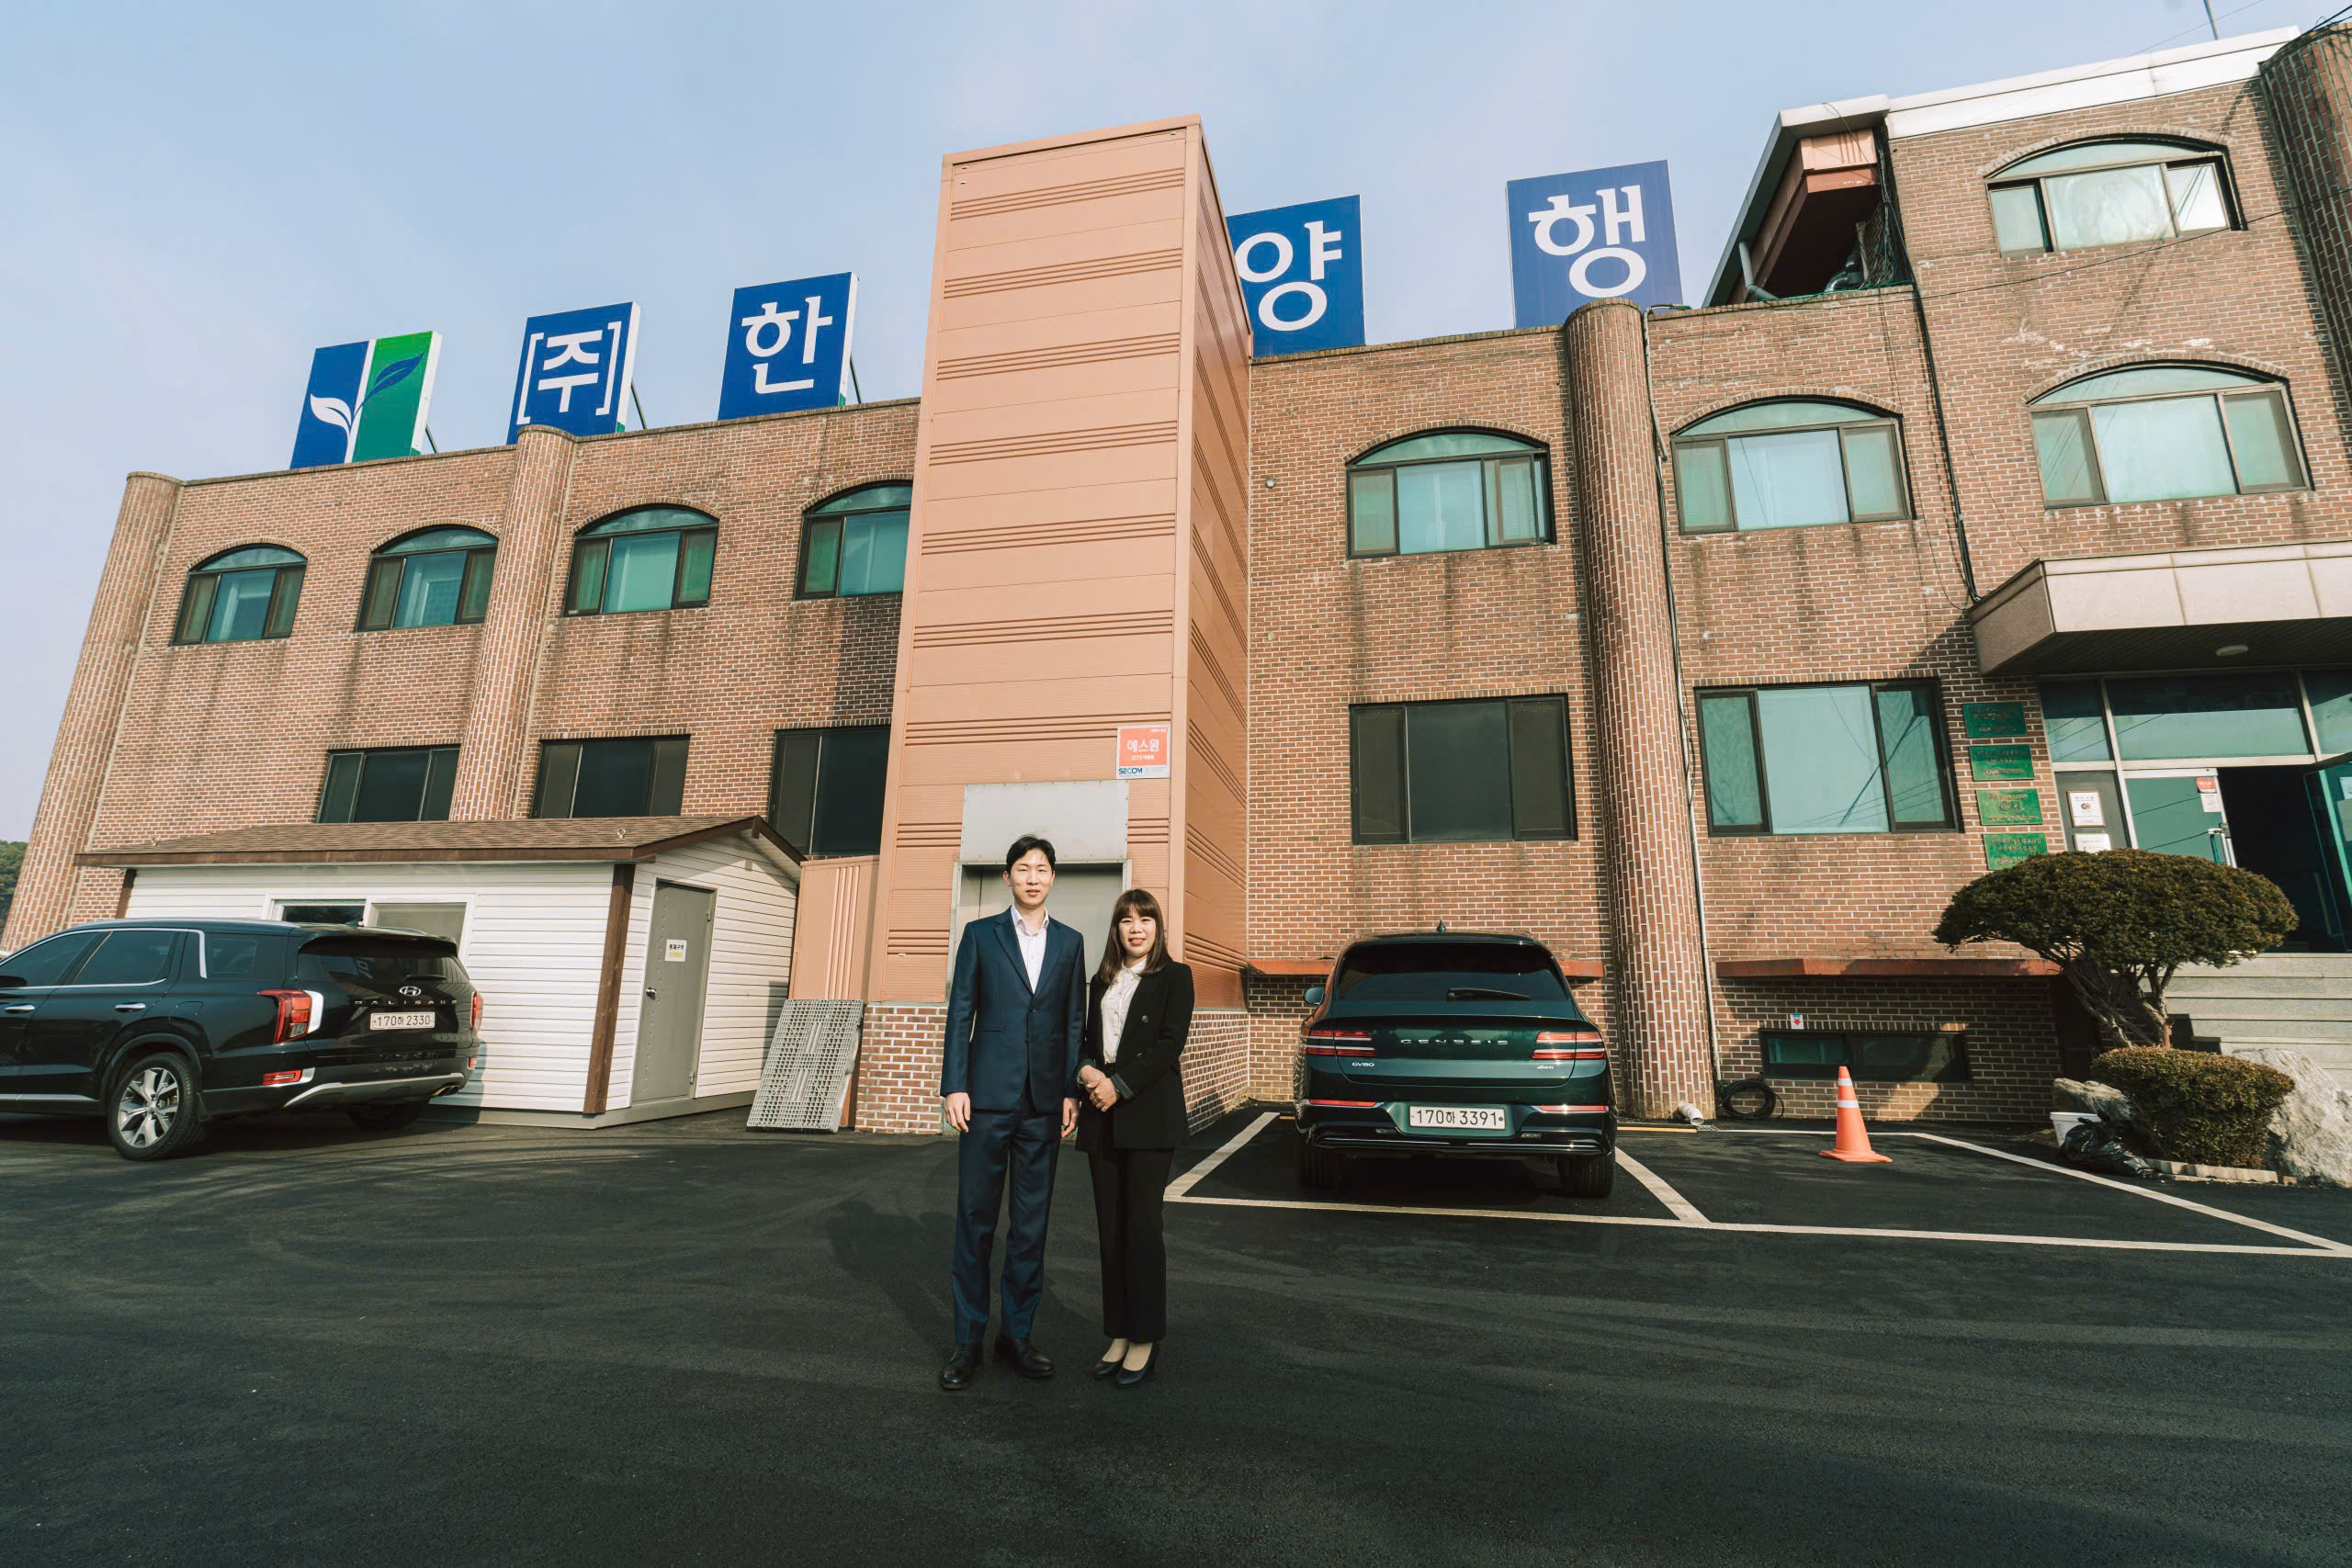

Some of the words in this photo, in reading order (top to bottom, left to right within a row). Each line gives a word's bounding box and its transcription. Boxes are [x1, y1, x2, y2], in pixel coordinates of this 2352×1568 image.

[741, 296, 833, 395] 한
[1234, 220, 1342, 332] 양
[1528, 185, 1646, 299] 행
[1126, 739, 1159, 752] 에스원
[406, 1014, 430, 1026] 2330
[1416, 1109, 1456, 1124] 170하
[1459, 1111, 1498, 1126] 3391
